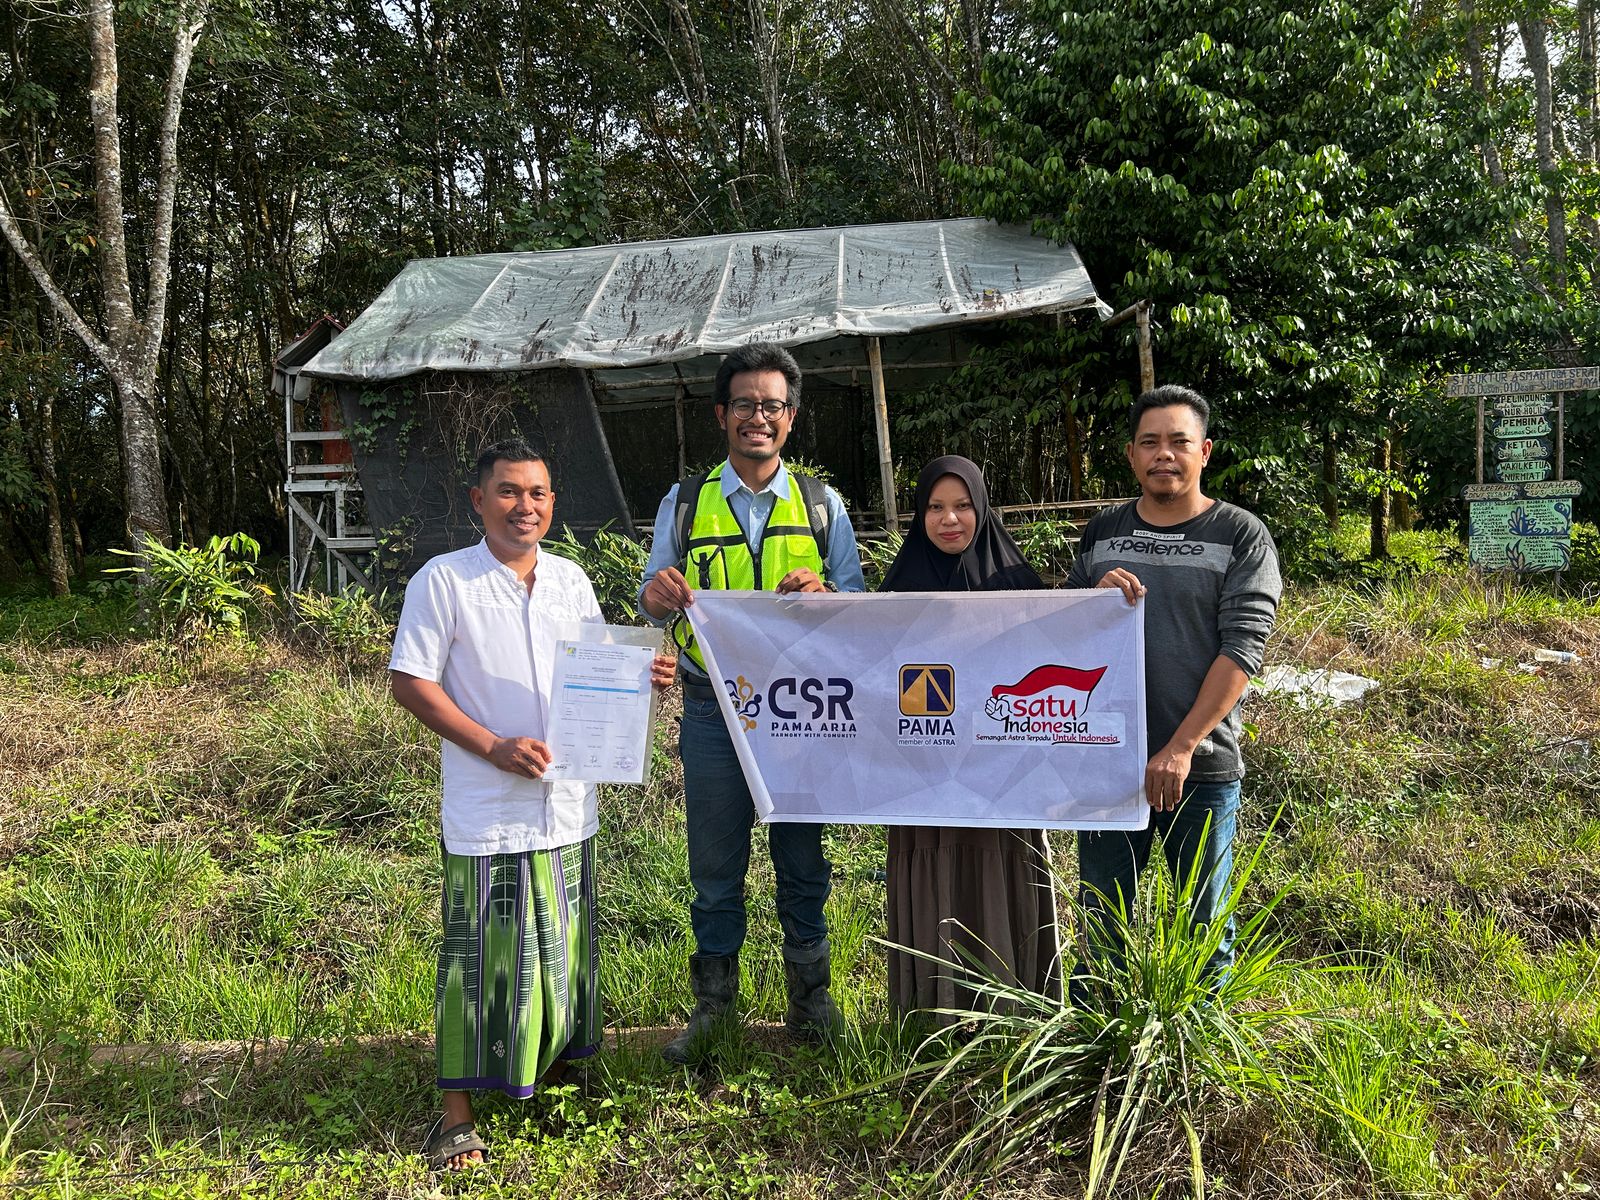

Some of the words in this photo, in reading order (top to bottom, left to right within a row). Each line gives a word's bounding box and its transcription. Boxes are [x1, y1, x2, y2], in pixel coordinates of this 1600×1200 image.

[1453, 372, 1508, 385] STRUKTUR
[1570, 368, 1598, 378] SERAT
[1541, 379, 1575, 391] SUMBER
[1500, 394, 1546, 403] PELINDUNG
[1504, 408, 1521, 416] NUR
[1502, 417, 1545, 427] PEMBINA
[1507, 440, 1539, 449] KETUA
[1500, 462, 1523, 471] WAKIL
[1523, 461, 1550, 470] KETUA
[1504, 471, 1544, 481] NURMIATI
[768, 677, 855, 721] CSR
[1013, 694, 1077, 718] satu
[771, 722, 813, 732] PAMA
[820, 722, 857, 732] ARIA
[898, 718, 956, 736] PAMA
[1003, 715, 1089, 734] Indonesia
[898, 736, 923, 746] member
[925, 738, 932, 746] of
[976, 734, 1007, 743] Semangat
[1027, 734, 1051, 742] Terpadu
[1052, 733, 1077, 742] Untuk
[1079, 733, 1119, 743] Indonesia
